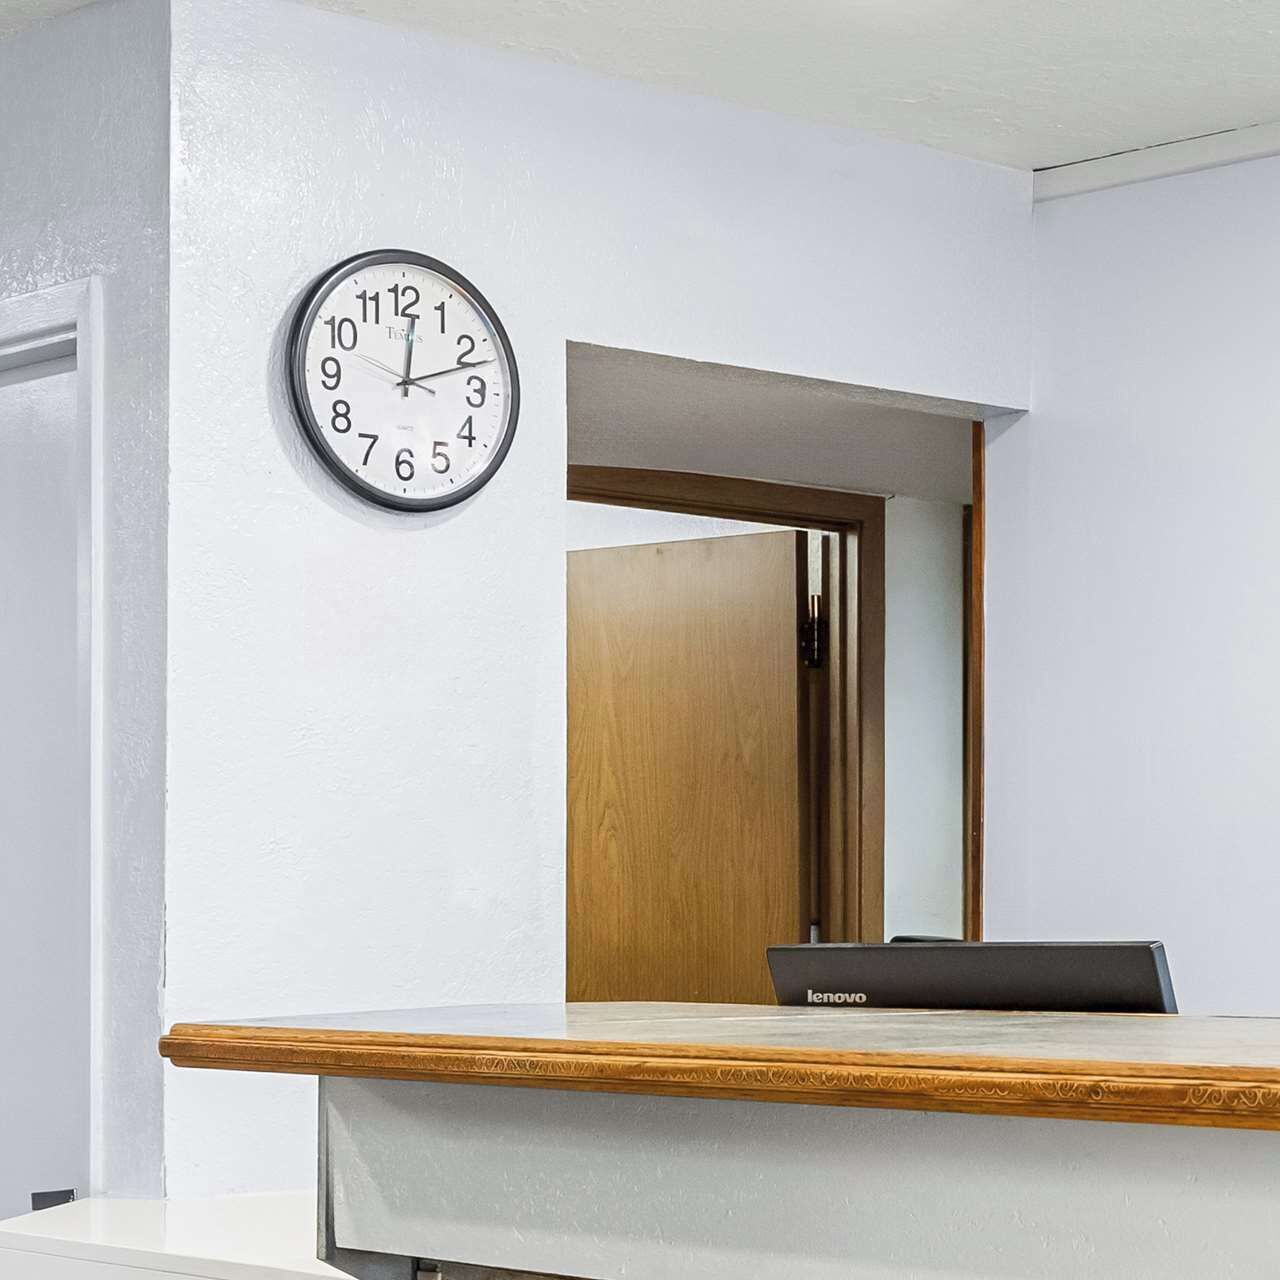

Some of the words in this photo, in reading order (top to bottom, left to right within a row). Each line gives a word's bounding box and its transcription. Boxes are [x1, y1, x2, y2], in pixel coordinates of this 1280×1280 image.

[356, 290, 380, 324] 11
[388, 284, 420, 319] 12
[434, 301, 446, 334] 1
[324, 316, 357, 351] 10
[456, 335, 475, 366] 2
[321, 357, 342, 390] 9
[466, 375, 486, 408] 3
[331, 399, 352, 433] 8
[456, 416, 476, 447] 4
[358, 433, 379, 466] 7
[395, 448, 414, 481] 6
[431, 441, 450, 474] 5
[807, 989, 867, 1003] lenovo
